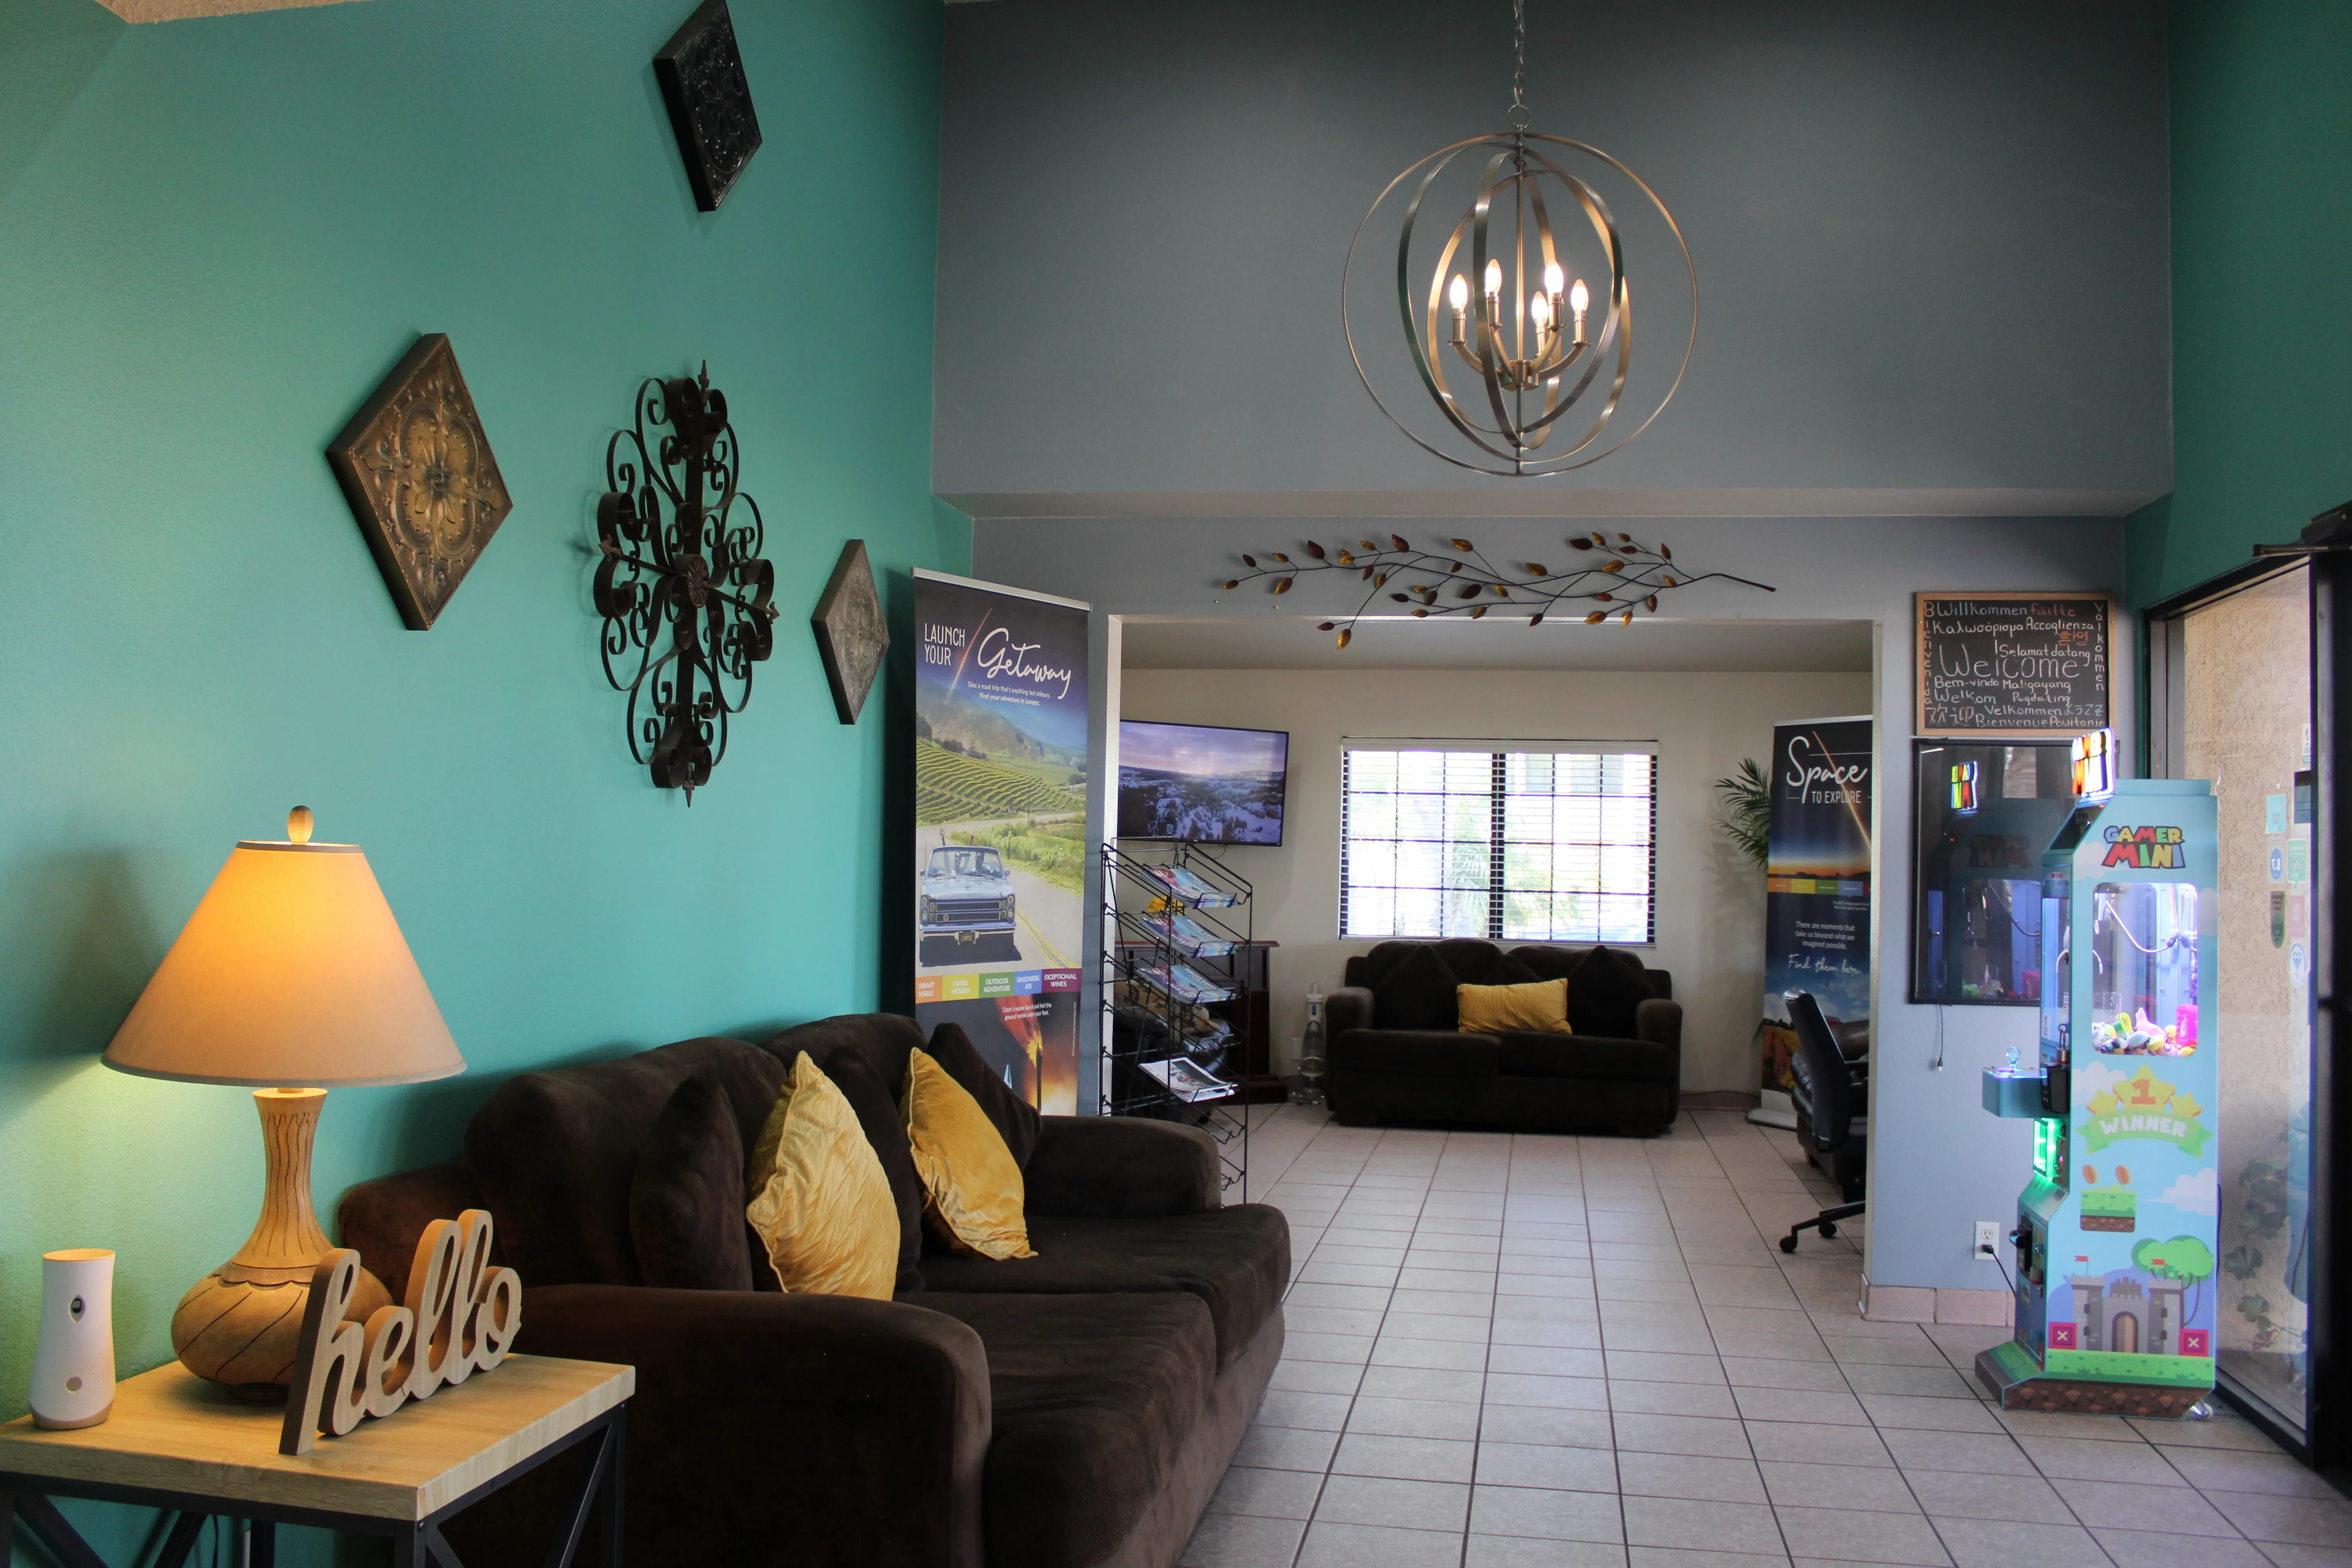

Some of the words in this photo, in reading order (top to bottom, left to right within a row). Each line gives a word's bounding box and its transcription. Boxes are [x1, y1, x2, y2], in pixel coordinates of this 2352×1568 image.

[1937, 602, 2028, 616] Willkommen
[925, 623, 965, 647] LAUNCH
[2026, 617, 2094, 635] Accoglienza
[925, 644, 951, 666] YOUR
[1924, 601, 1935, 704] Bienvenida
[1939, 640, 2080, 678] Welcome
[2000, 644, 2049, 657] Selamat
[2051, 644, 2091, 666] datang
[977, 628, 1072, 699] Getaway
[1934, 675, 1999, 688] Bem-vindo
[2003, 679, 2071, 695] Maligayang
[1934, 688, 1997, 704] Welkom
[1984, 704, 2063, 716] Velkommen
[1976, 713, 2047, 728] Bienvenue
[2049, 715, 2105, 728] Powitanie
[1786, 736, 1868, 804] Space
[1811, 791, 1822, 804] TO
[1825, 791, 1862, 804] EXPLORE
[2103, 826, 2185, 844] GAMER
[2101, 842, 2186, 869] MINI
[1802, 940, 1825, 948] imagined
[1788, 954, 1811, 969] Find
[1815, 957, 1839, 973] them
[2131, 1079, 2157, 1105] 1
[2099, 1115, 2187, 1137] WINNER
[279, 1209, 522, 1456] hello
